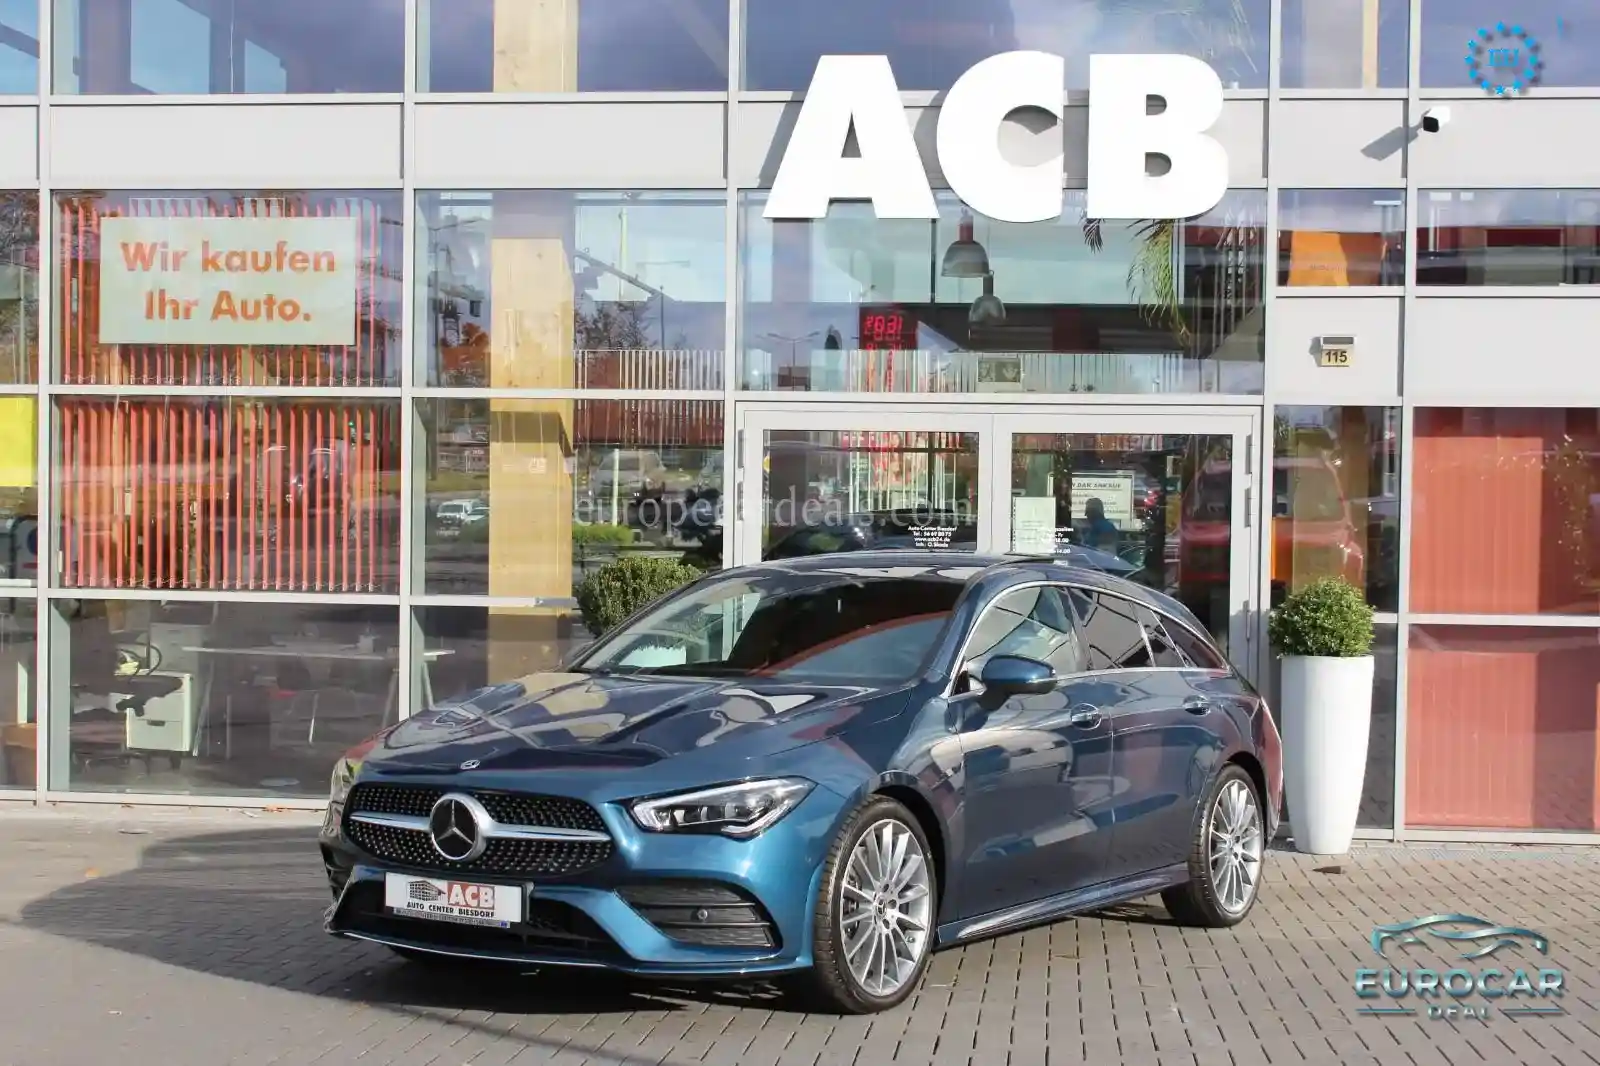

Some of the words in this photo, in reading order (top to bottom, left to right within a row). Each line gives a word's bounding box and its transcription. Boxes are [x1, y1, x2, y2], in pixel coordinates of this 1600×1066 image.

[762, 50, 1229, 223] ACB
[120, 240, 188, 273] Wir
[201, 240, 336, 273] kaufen
[144, 288, 199, 321] Ihr
[210, 290, 312, 322] Auto.
[1325, 350, 1348, 363] 115
[407, 902, 425, 910] AUTO
[428, 902, 454, 914] CENTER
[458, 907, 495, 918] BIESDORF
[448, 884, 495, 909] ACB
